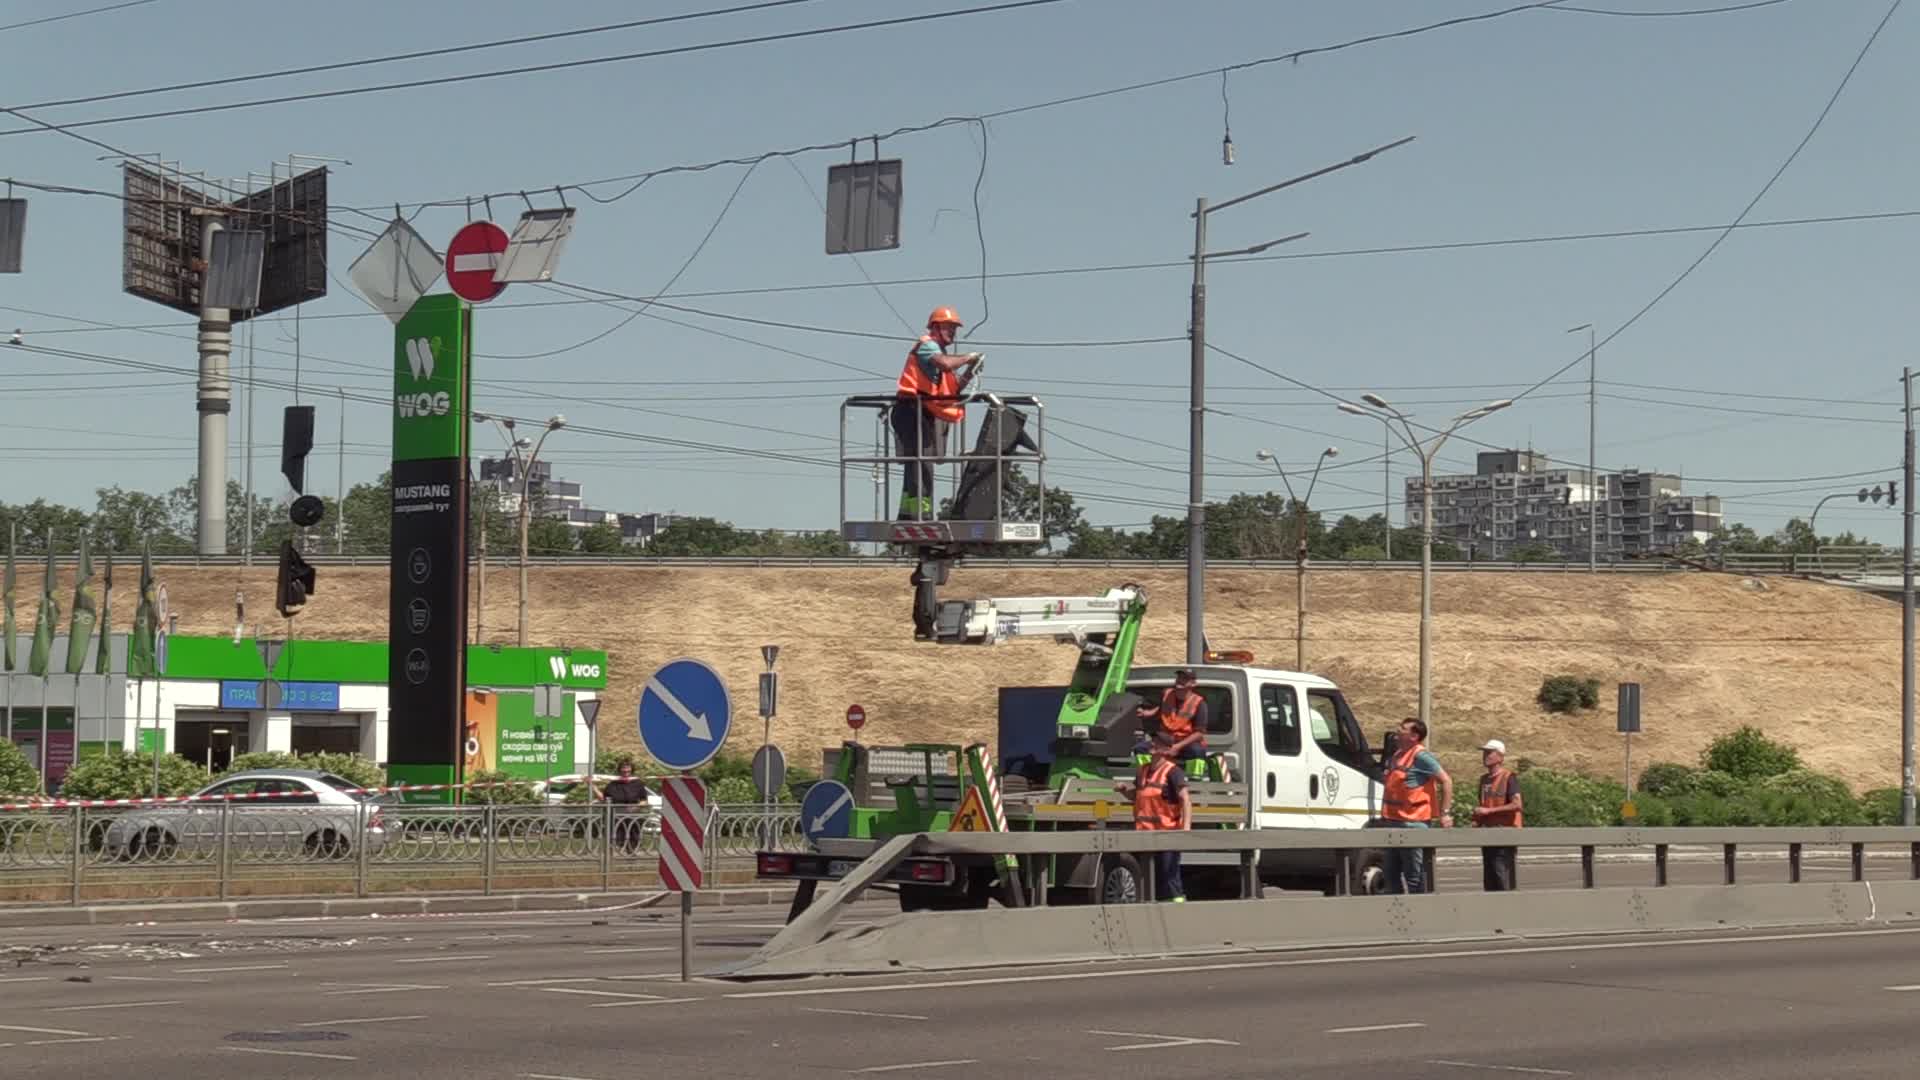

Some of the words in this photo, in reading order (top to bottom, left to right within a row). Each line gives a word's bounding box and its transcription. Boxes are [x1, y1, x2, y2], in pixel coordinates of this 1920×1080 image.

[398, 391, 450, 418] WOG
[394, 484, 450, 499] MUSTANG
[571, 664, 600, 678] WOG
[532, 743, 563, 753] смауй
